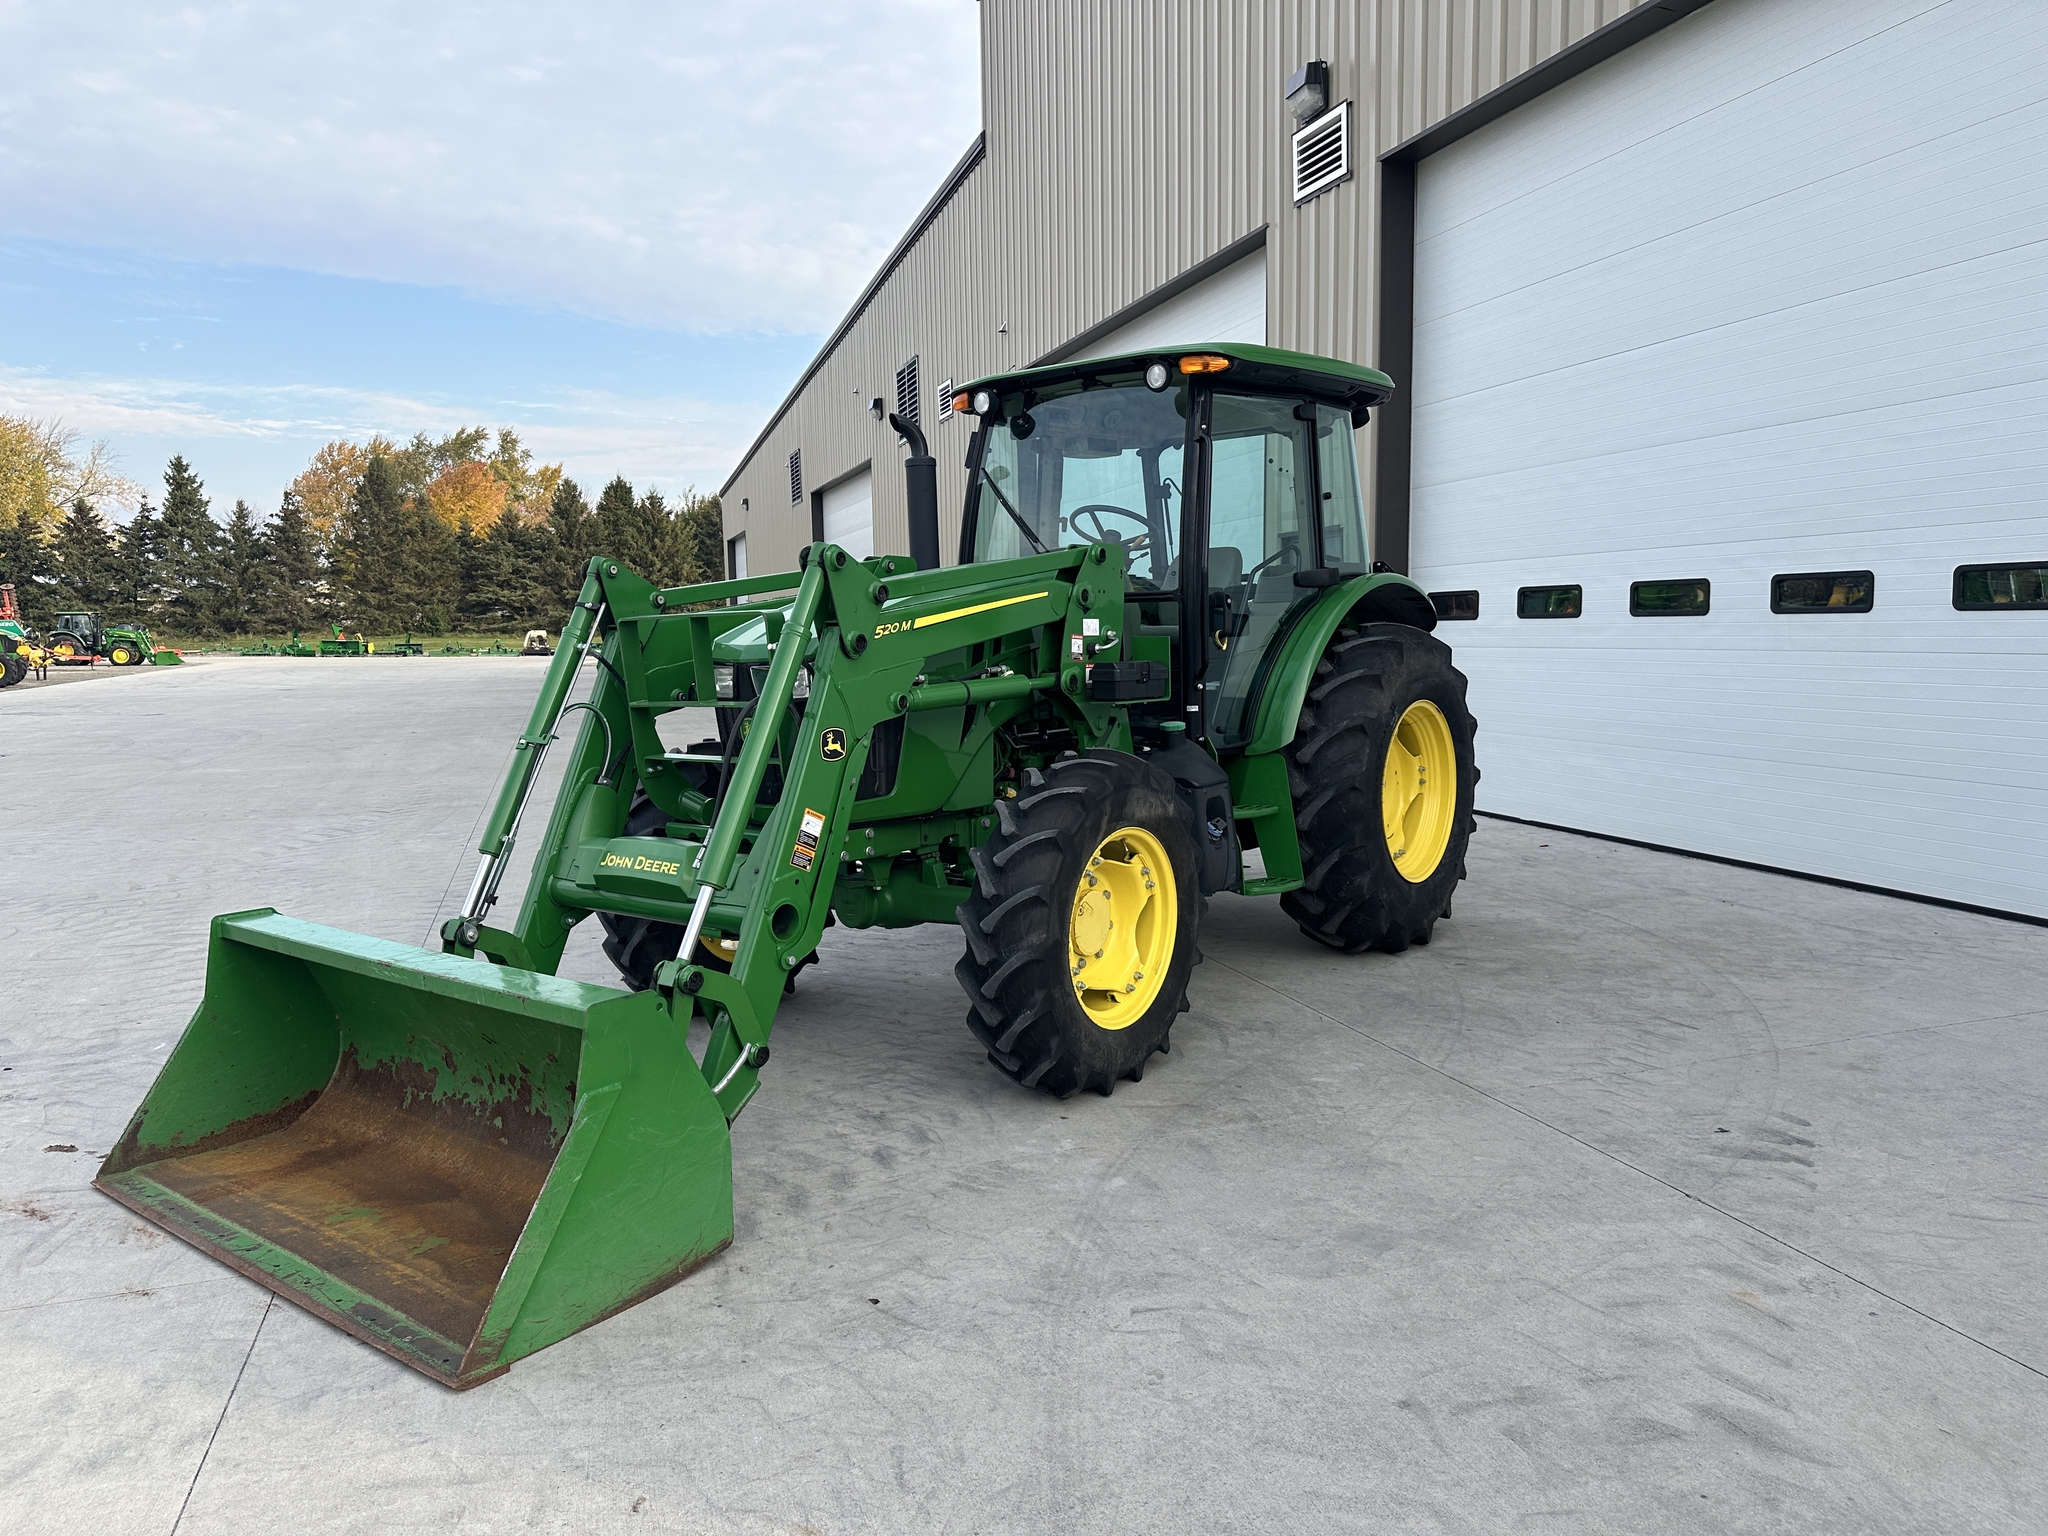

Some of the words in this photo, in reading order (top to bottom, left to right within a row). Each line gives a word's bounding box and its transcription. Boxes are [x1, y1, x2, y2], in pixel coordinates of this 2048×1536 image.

[873, 622, 900, 639] 520
[900, 619, 912, 632] M
[600, 852, 634, 869] JOHN
[634, 855, 681, 876] DEERE
